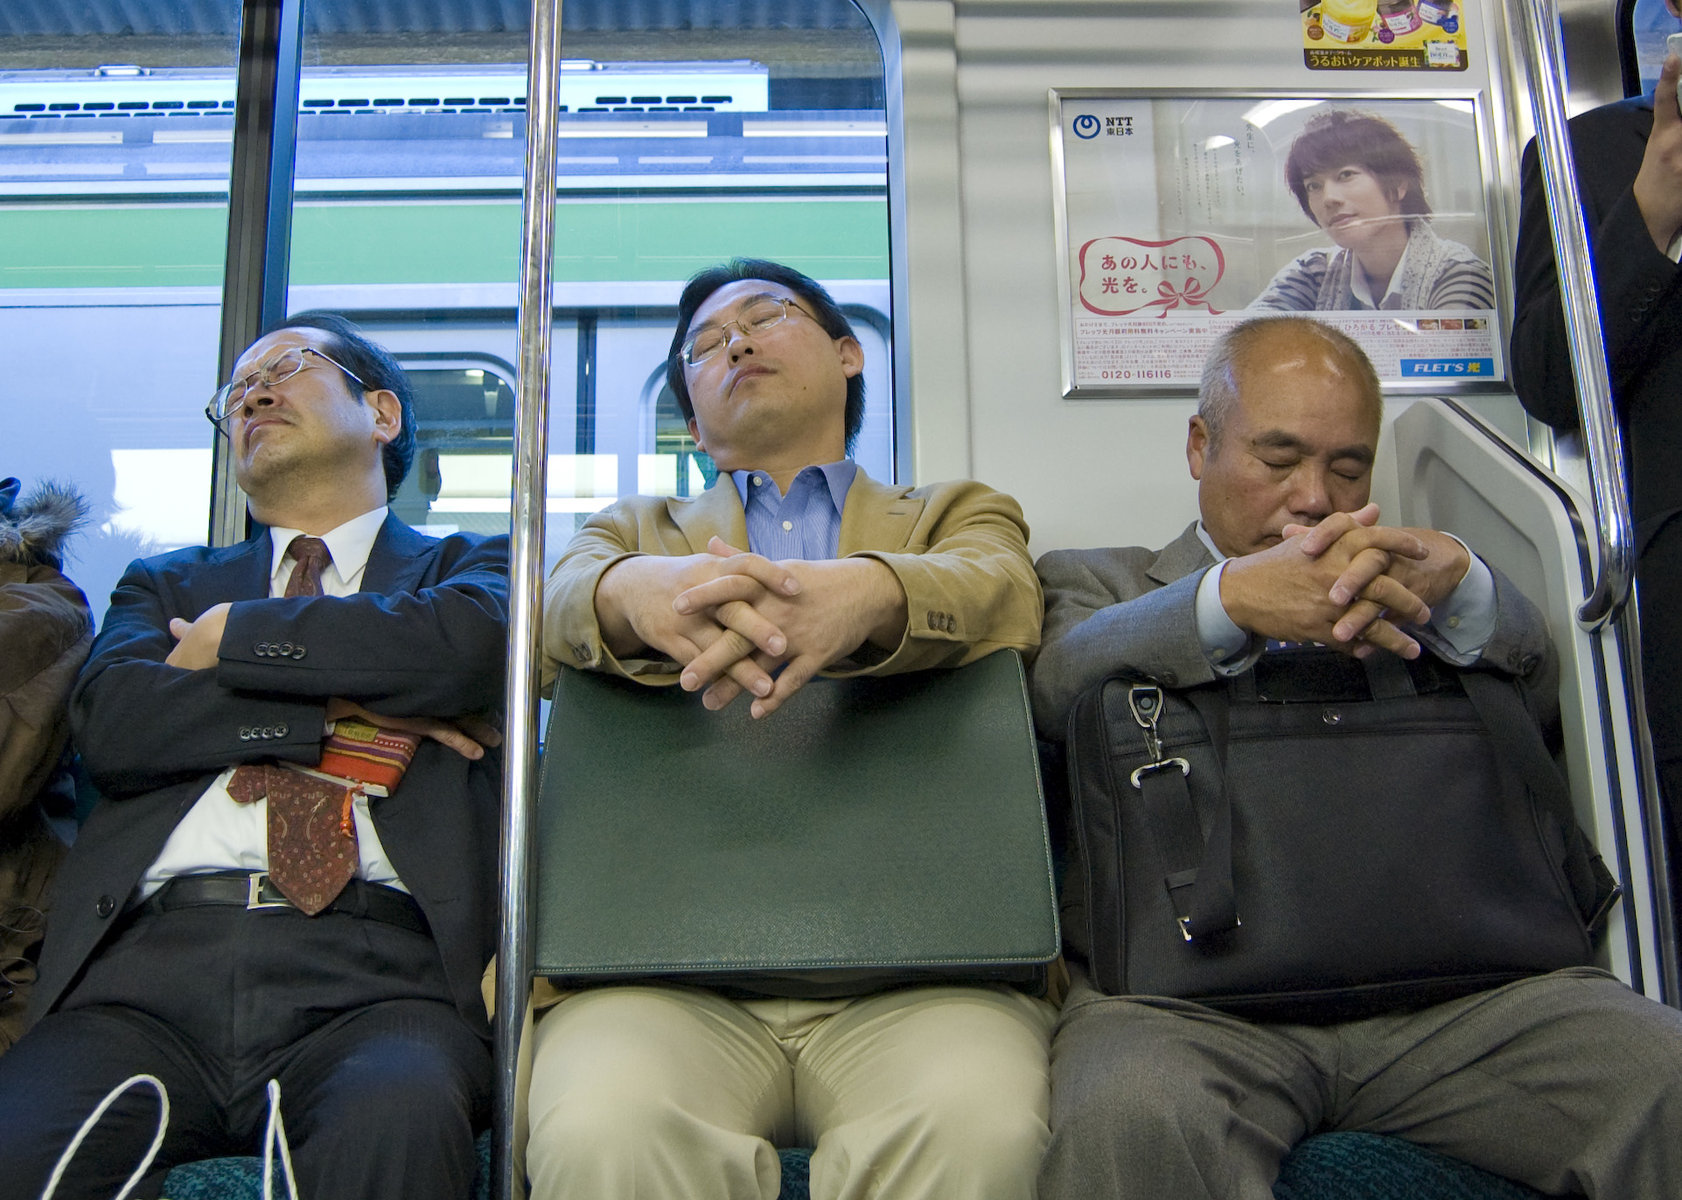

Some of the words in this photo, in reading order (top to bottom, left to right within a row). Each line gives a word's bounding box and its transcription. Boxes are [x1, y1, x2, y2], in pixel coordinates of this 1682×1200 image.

[1310, 55, 1421, 67] うるおいケアポット誕生
[1106, 116, 1133, 126] NTT
[1106, 127, 1134, 136] 東日本
[1101, 254, 1206, 271] あの人にも、
[1102, 276, 1148, 294] 光を。
[1414, 363, 1465, 373] FLET'S
